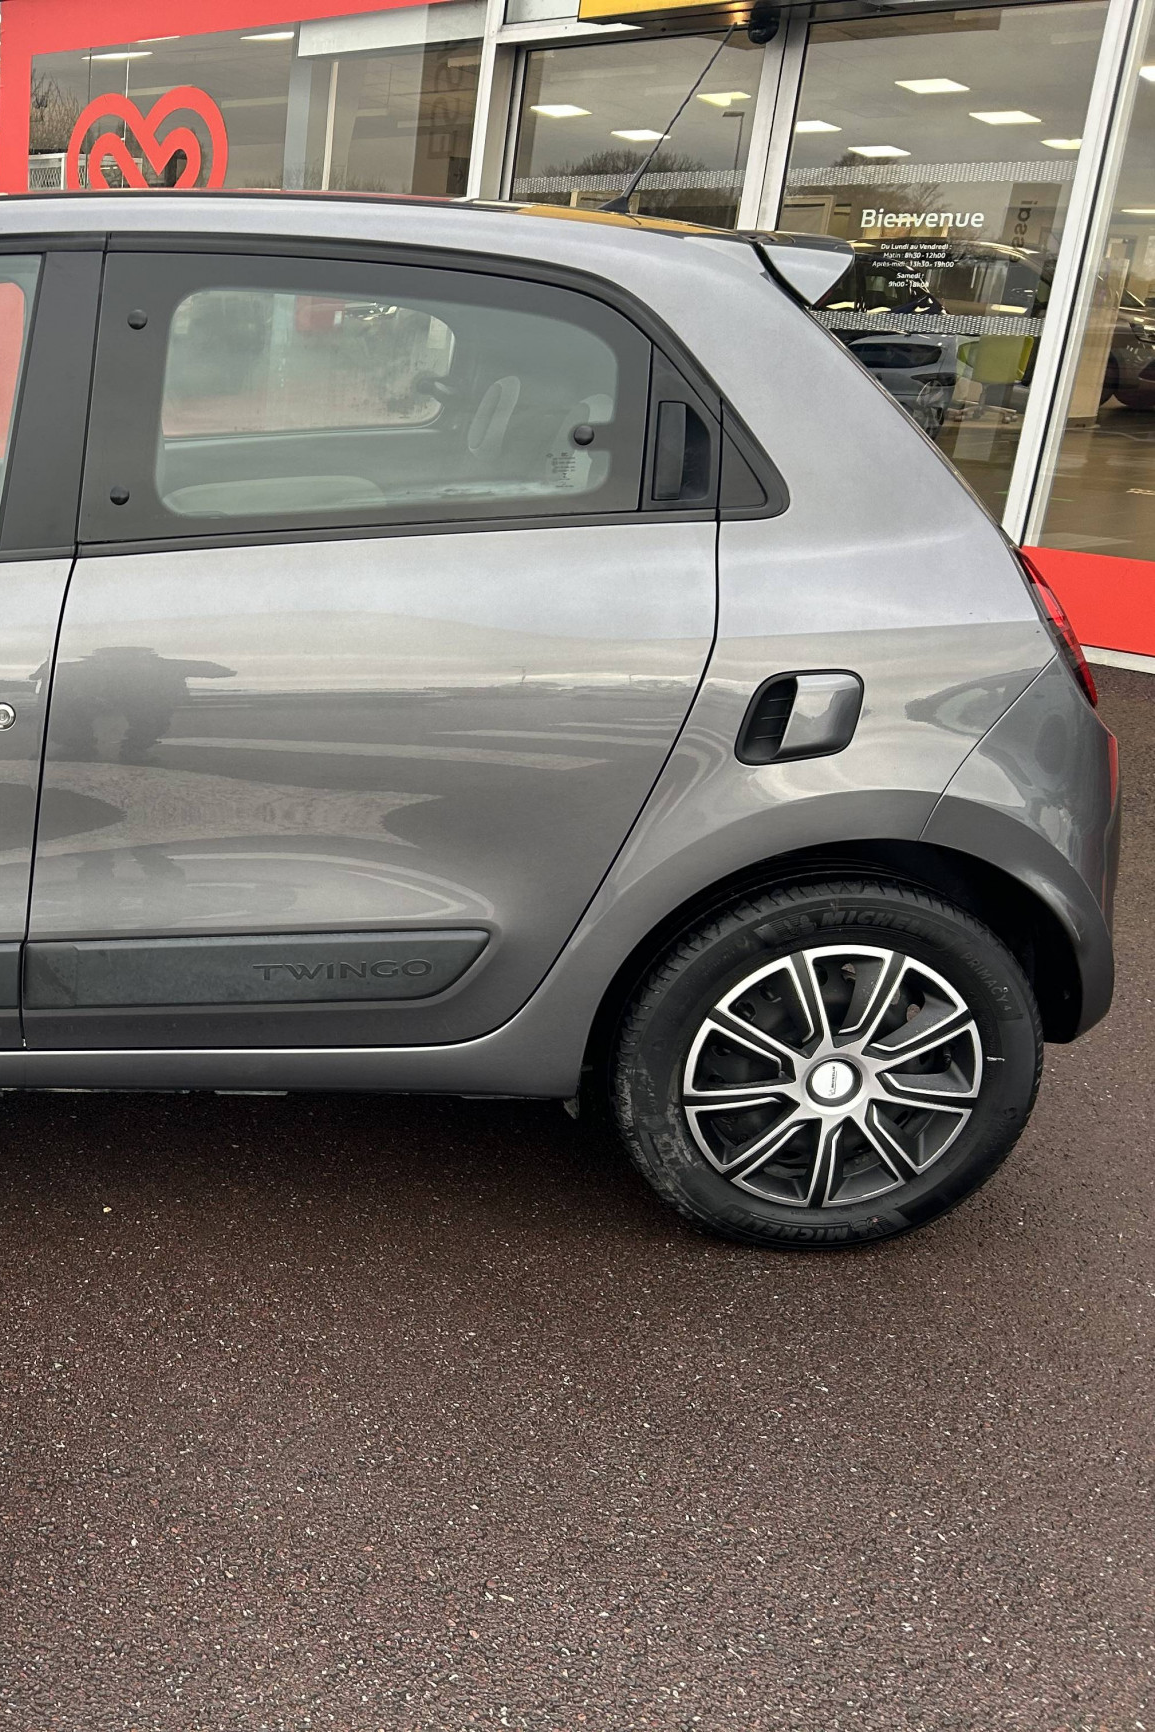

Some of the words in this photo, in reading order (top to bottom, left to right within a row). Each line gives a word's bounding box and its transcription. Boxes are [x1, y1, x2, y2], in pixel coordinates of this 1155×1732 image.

[861, 208, 985, 228] Bienvenue
[934, 260, 955, 268] 19h00
[252, 958, 433, 981] TWINGO
[961, 951, 1009, 1007] PRIMACY
[721, 1208, 847, 1241] MICHELIN
